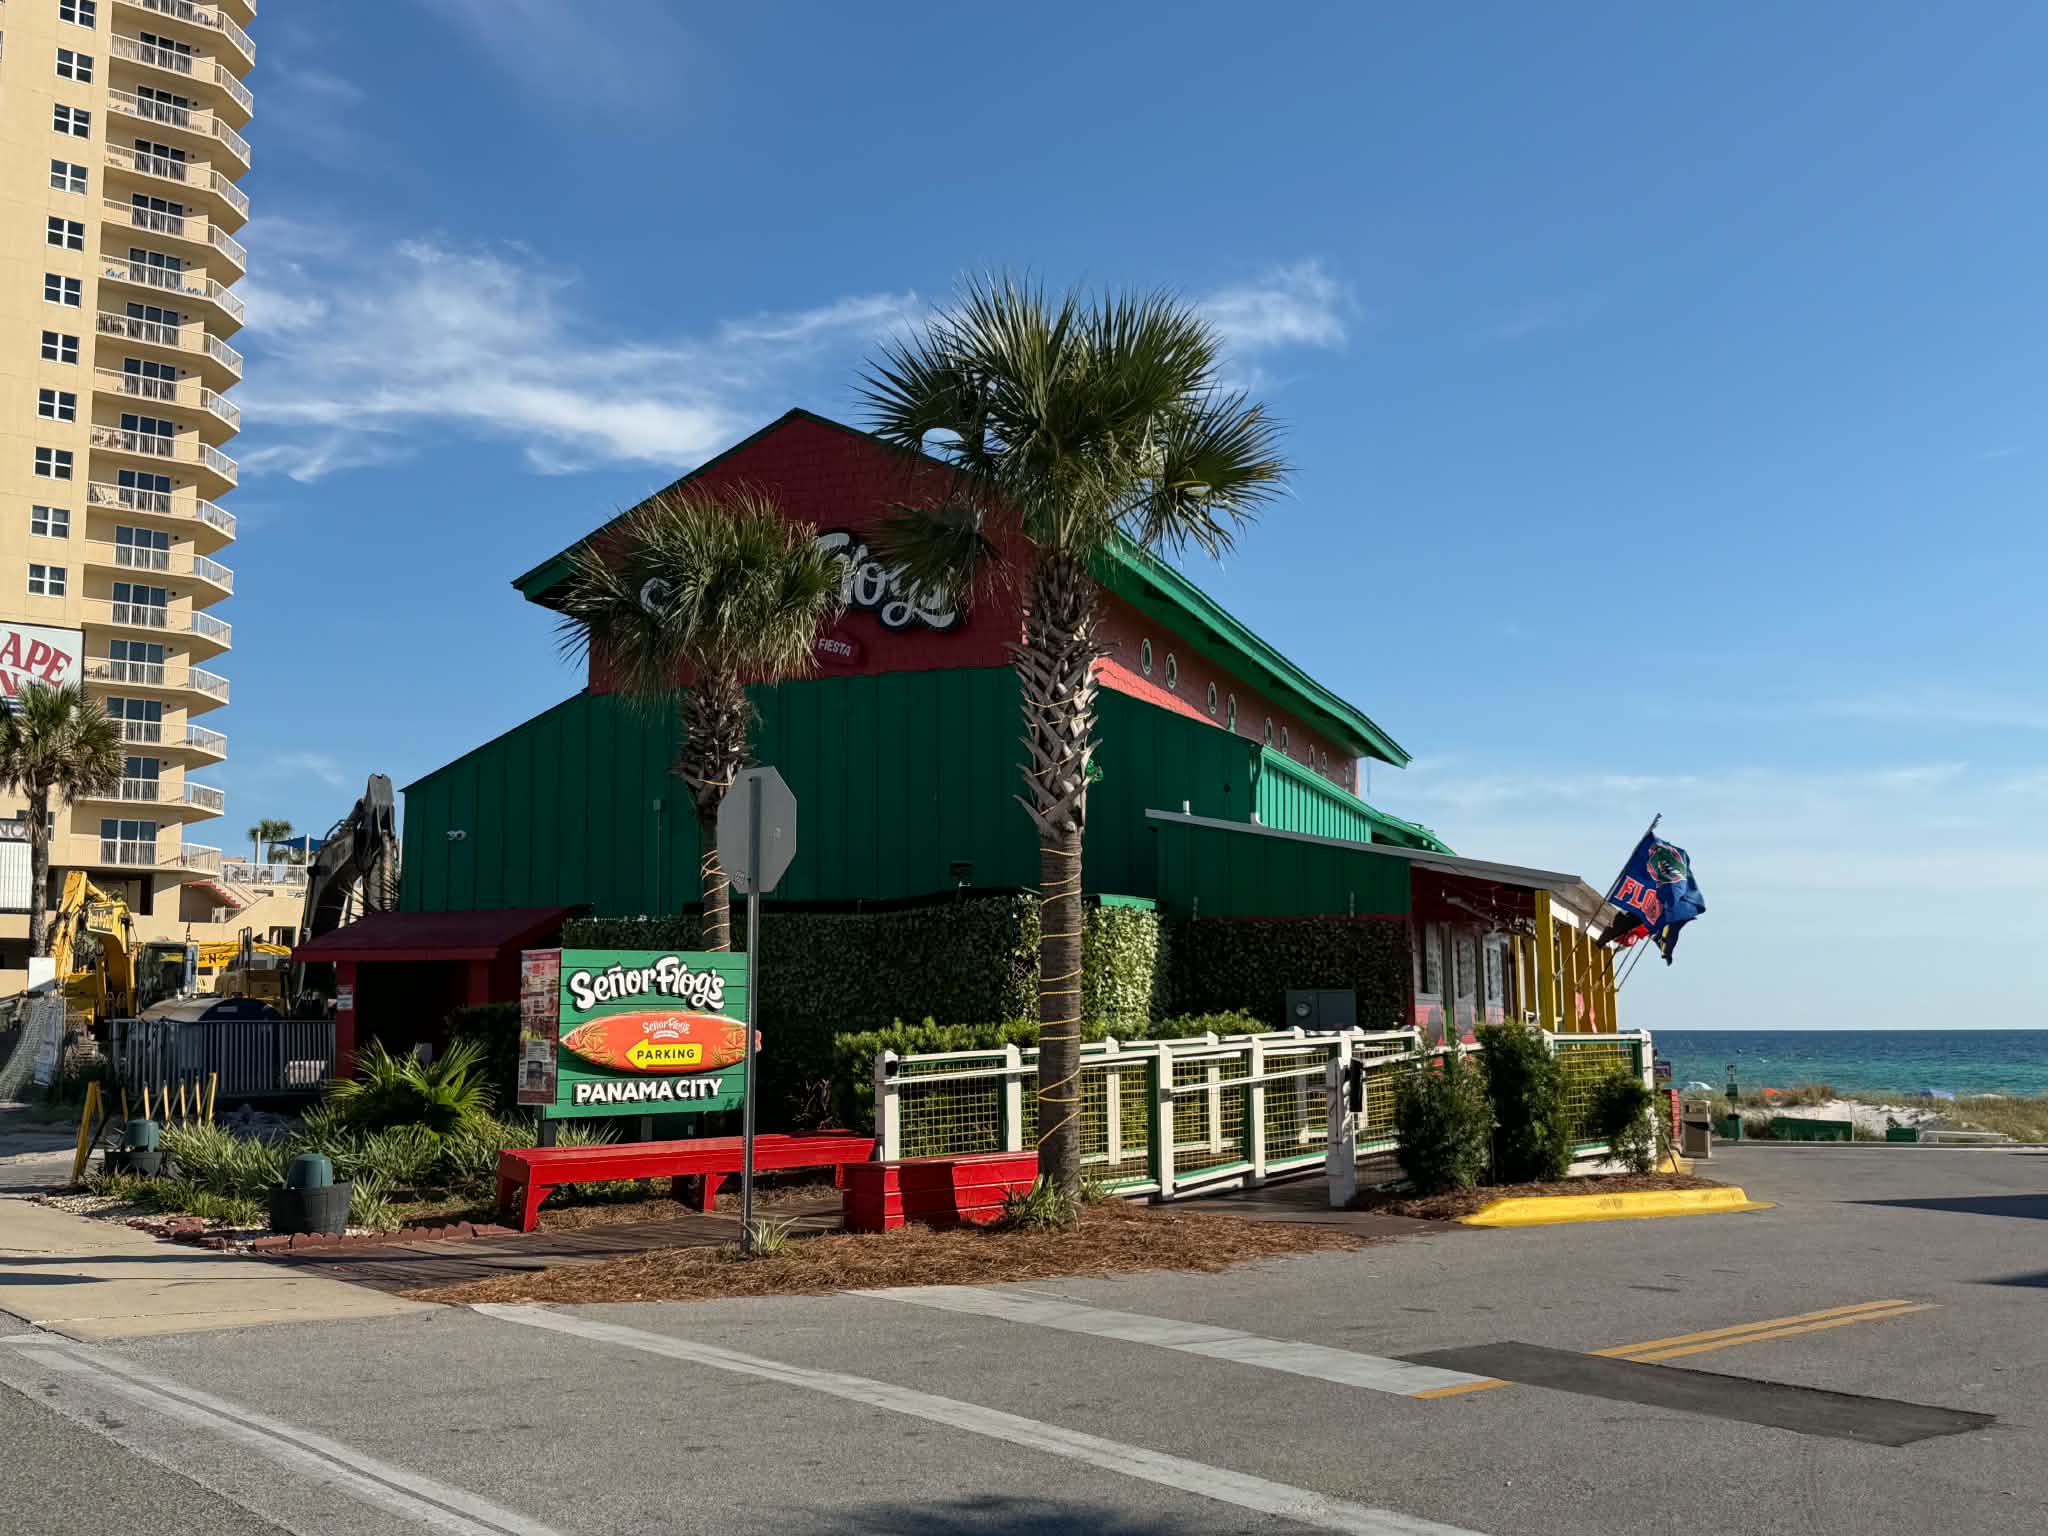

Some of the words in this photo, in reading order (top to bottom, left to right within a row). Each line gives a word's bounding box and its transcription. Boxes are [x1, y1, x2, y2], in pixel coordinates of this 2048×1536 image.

[818, 638, 851, 657] FIESTA
[569, 965, 657, 1010] Señor
[655, 956, 726, 1010] Frog's
[636, 1048, 695, 1061] PARKING
[575, 1079, 674, 1104] PANAMA
[675, 1077, 724, 1098] CITY
